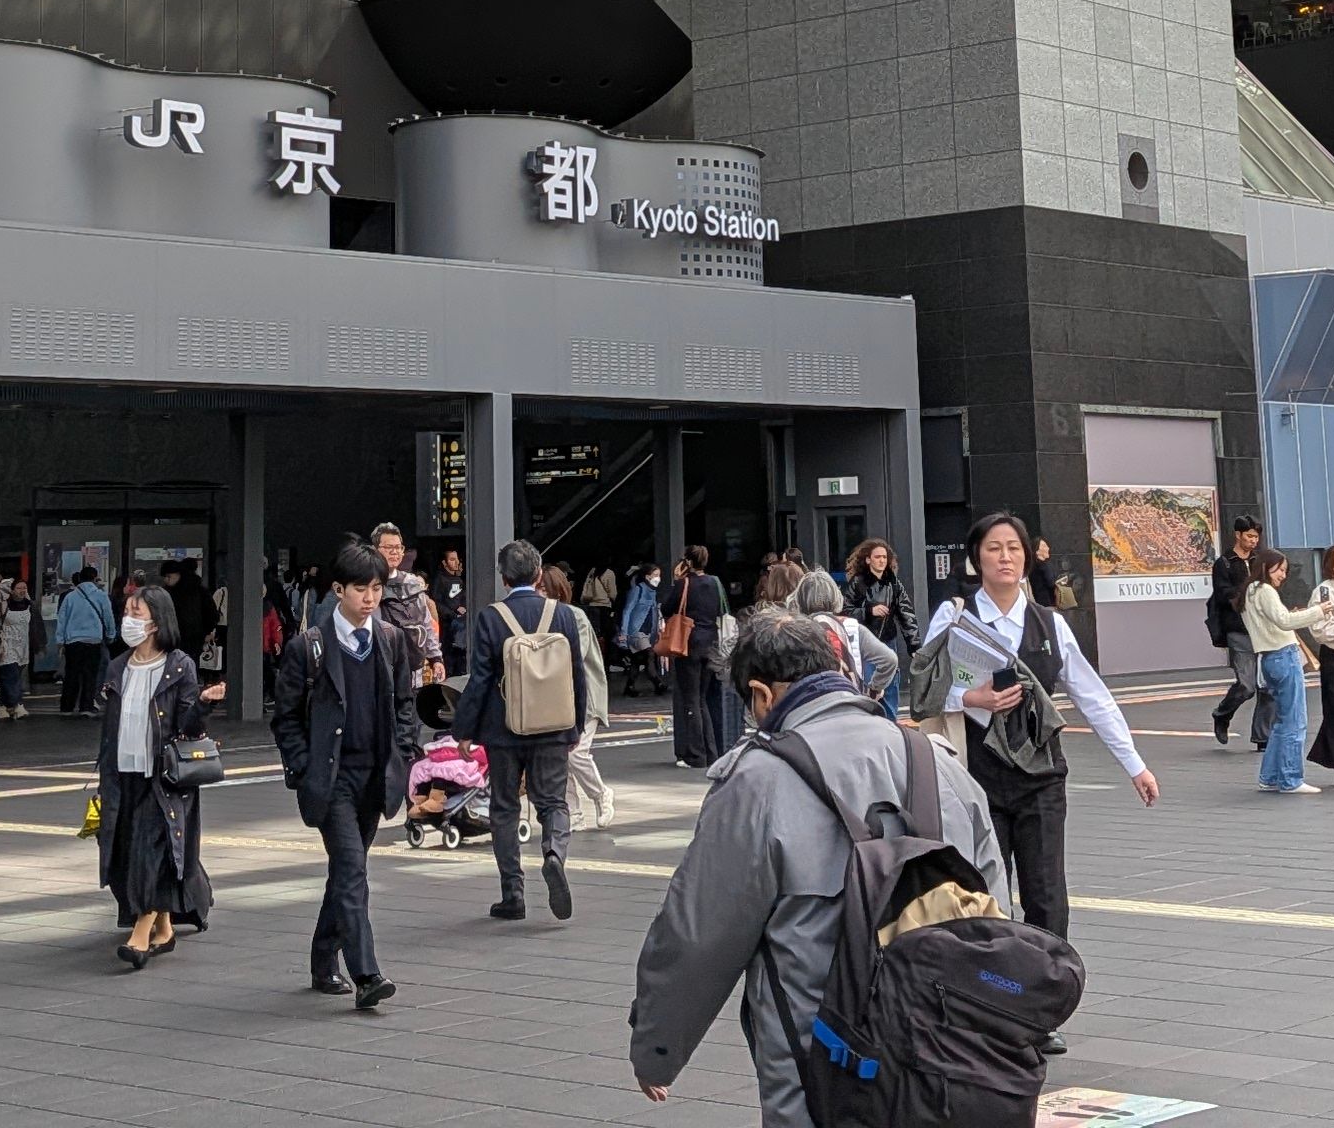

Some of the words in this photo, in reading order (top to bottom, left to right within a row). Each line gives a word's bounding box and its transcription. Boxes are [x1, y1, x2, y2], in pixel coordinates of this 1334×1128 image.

[131, 98, 205, 154] JR
[274, 107, 343, 195] 京
[542, 140, 599, 223] 都
[633, 198, 698, 239] Kyoto
[704, 205, 780, 242] Station
[1119, 583, 1152, 596] KYOTO
[1155, 582, 1196, 595] STATION
[980, 970, 1022, 992] OUTDOOR
